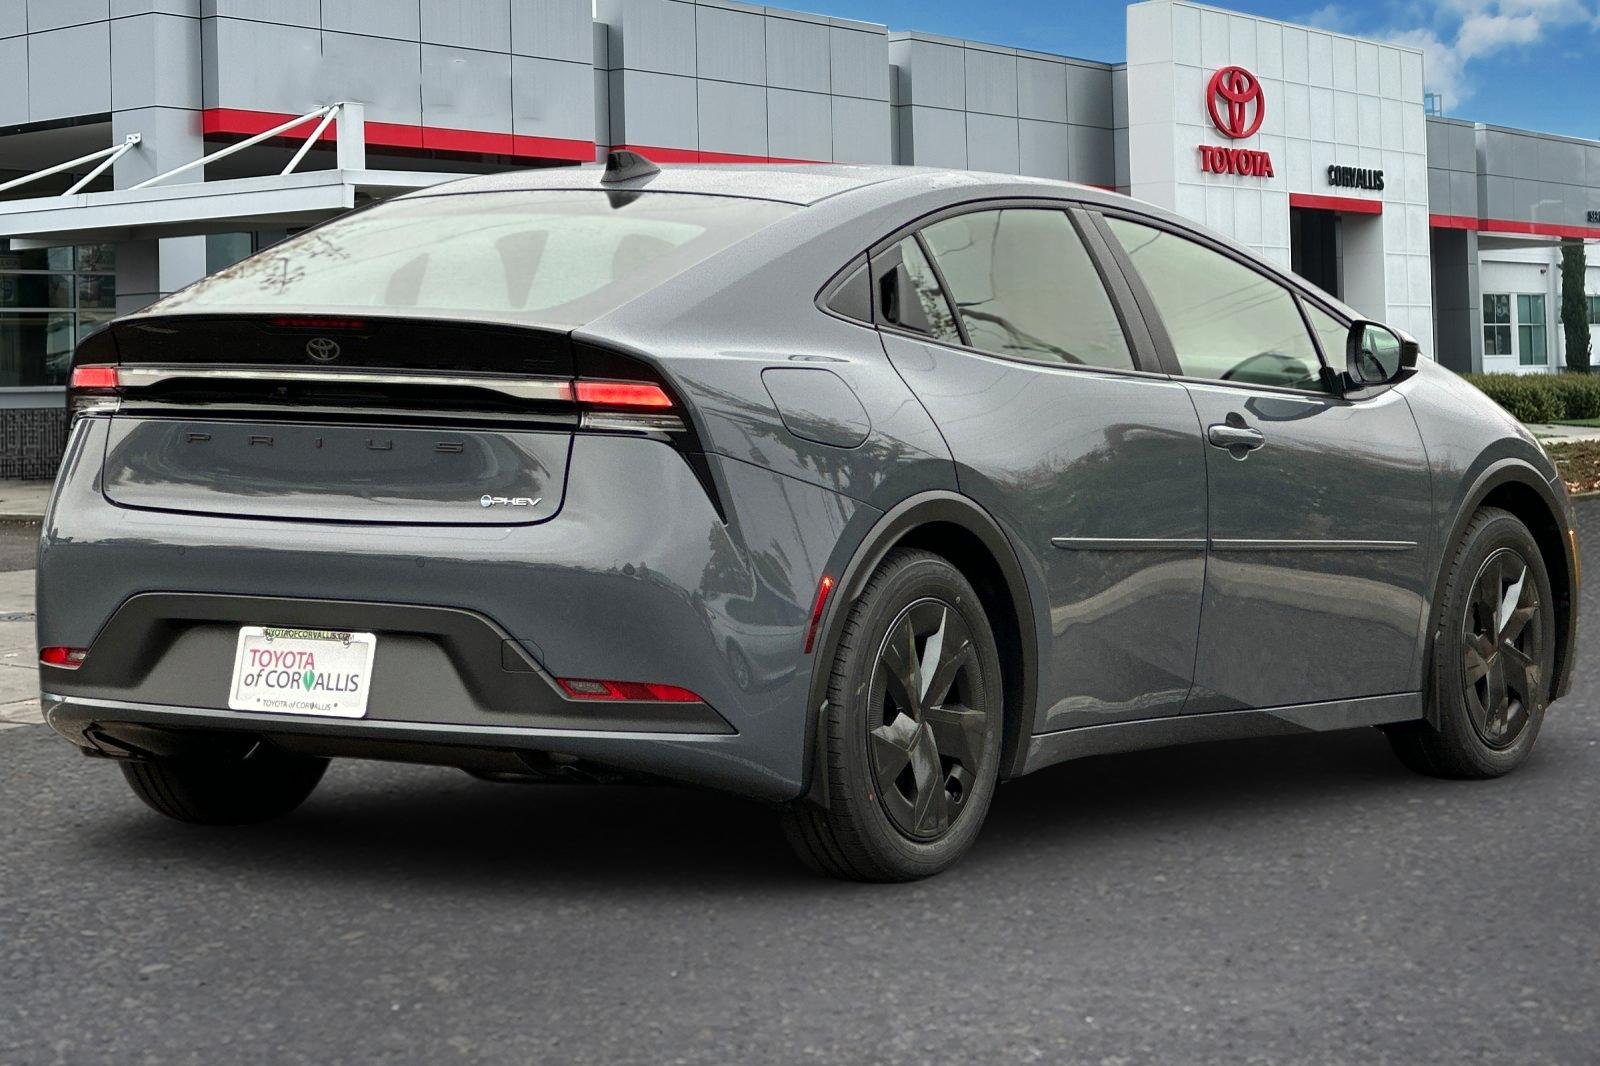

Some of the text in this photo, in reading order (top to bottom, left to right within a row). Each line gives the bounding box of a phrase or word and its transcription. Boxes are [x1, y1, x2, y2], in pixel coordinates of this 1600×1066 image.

[1198, 145, 1274, 178] TOYOTA
[1327, 165, 1385, 190] CORVALLIS
[186, 432, 464, 453] PRIUS
[491, 496, 542, 506] PHEV
[249, 649, 316, 670] TOYOTA
[244, 669, 264, 687] of
[263, 699, 288, 708] TOYOTA
